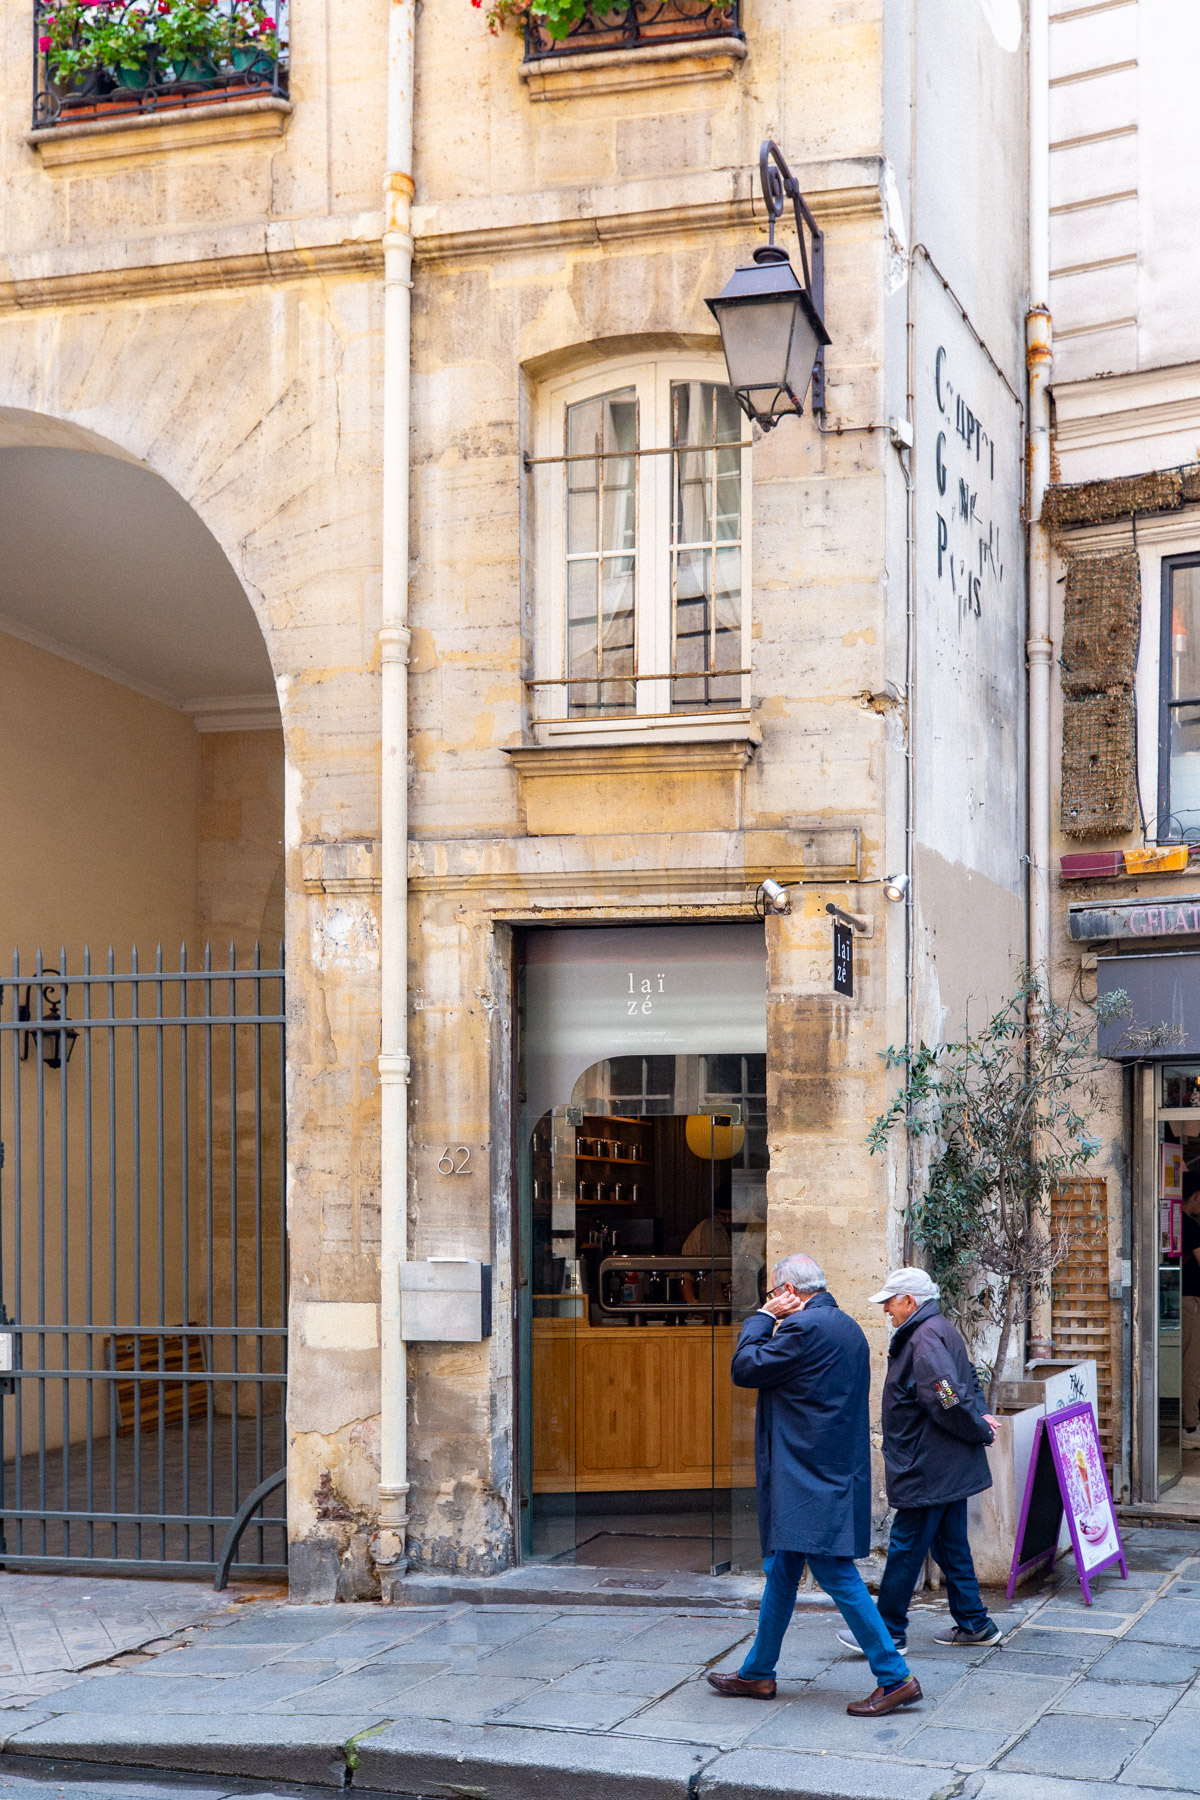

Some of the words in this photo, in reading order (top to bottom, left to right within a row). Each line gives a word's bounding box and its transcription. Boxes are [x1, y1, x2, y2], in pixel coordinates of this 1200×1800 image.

[627, 972, 666, 993] laï
[837, 961, 847, 983] zé
[627, 995, 652, 1015] zé
[437, 1146, 472, 1175] 62
